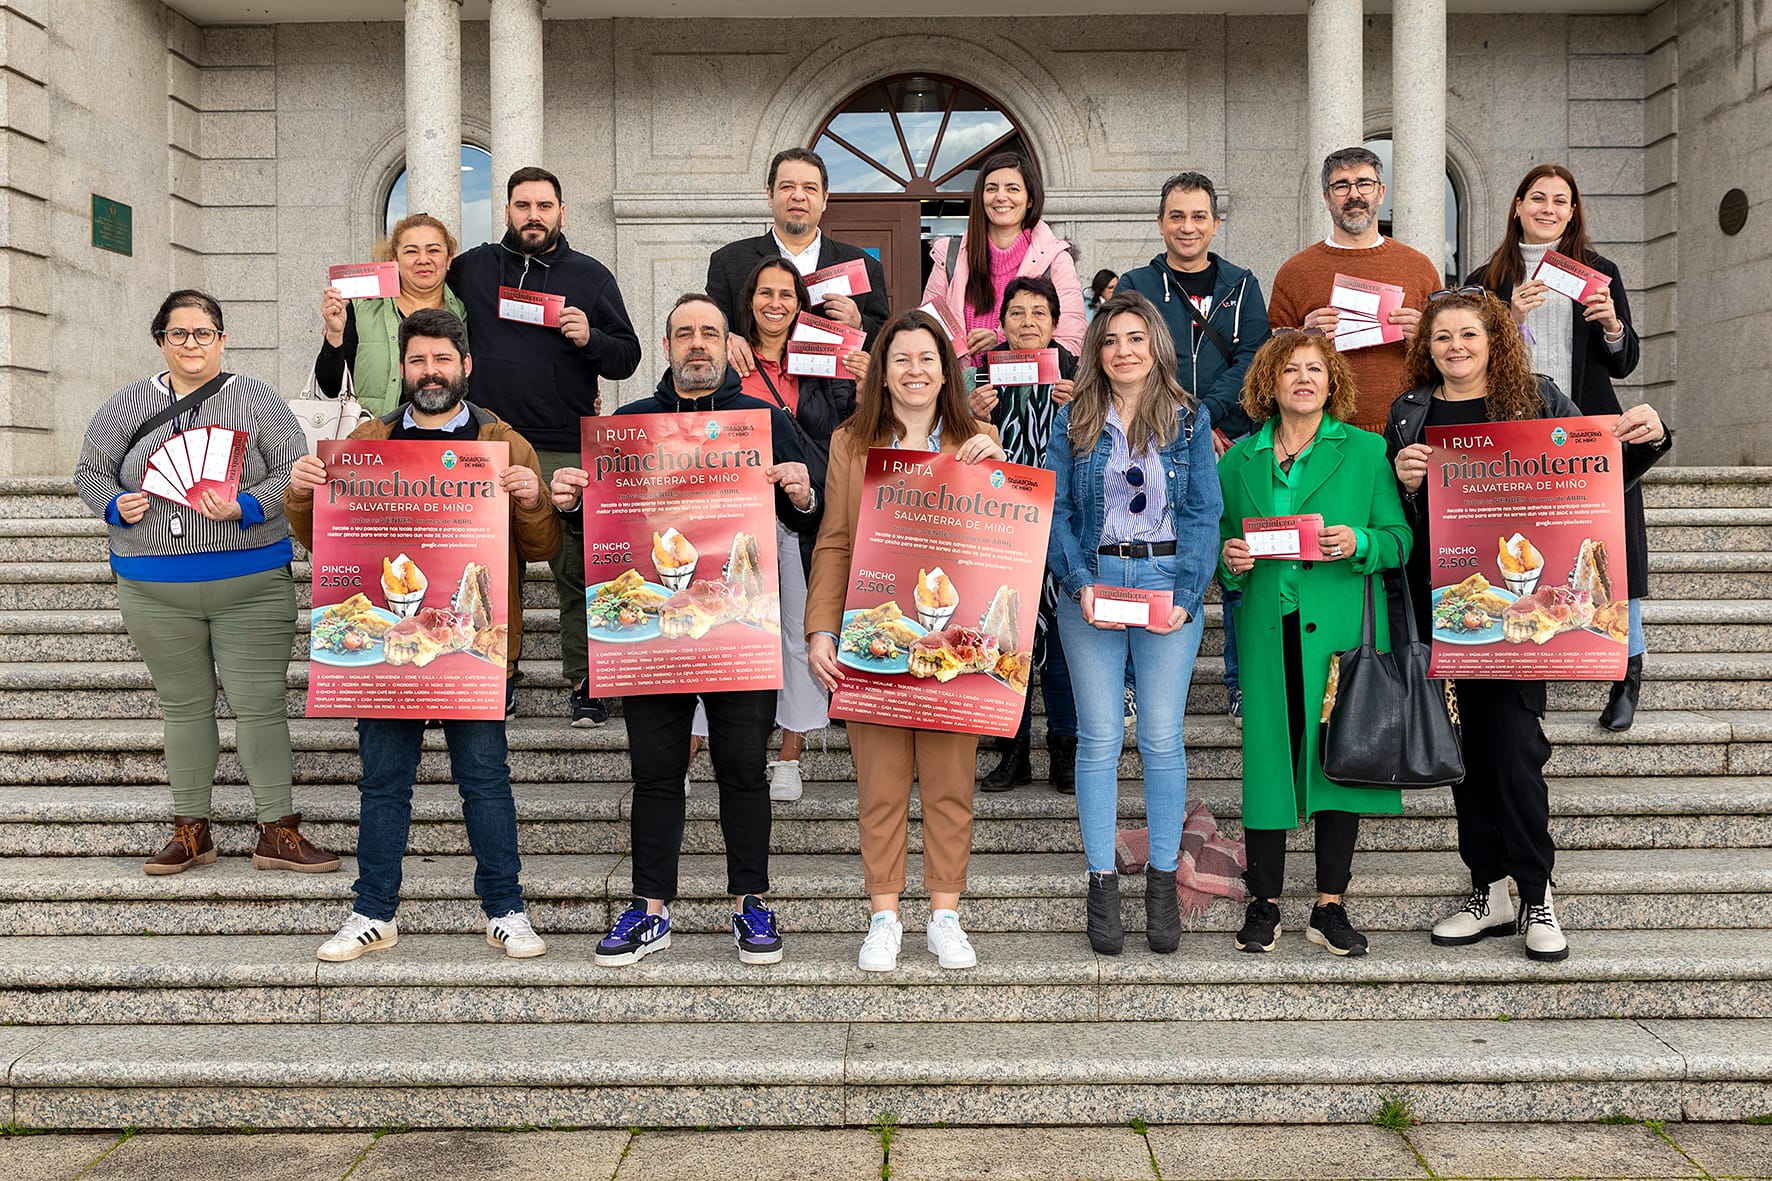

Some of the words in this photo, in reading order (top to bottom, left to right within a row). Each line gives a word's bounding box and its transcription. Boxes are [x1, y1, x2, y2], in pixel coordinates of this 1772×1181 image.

[606, 428, 648, 441] RUTA
[1453, 436, 1494, 449] RUTA
[342, 453, 384, 466] RUTA
[594, 443, 762, 482] pinchoterra
[892, 461, 934, 477] RUTA
[1441, 450, 1610, 488] pinchoterra
[615, 476, 687, 487] SALVATERRA
[690, 474, 705, 484] DE
[709, 472, 740, 483] MIÑO
[1462, 481, 1533, 494] SALVATERRA
[1537, 481, 1552, 491] DE
[1555, 478, 1587, 490] MIÑO
[328, 469, 497, 504] pinchoterra
[349, 502, 420, 512] SALVATERRA
[423, 503, 439, 512] DE
[443, 502, 474, 513] MIÑO
[874, 480, 1040, 523] pinchoterra
[894, 510, 962, 528] SALVATERRA
[965, 519, 981, 530] DE
[984, 519, 1016, 535] MIÑO
[592, 542, 631, 551] PINCHO
[1439, 546, 1477, 555] PINCHO
[591, 552, 633, 566] 2,50€
[1438, 556, 1479, 568] 2,50€
[321, 565, 360, 574] PINCHO
[859, 569, 896, 582] PINCHO
[320, 575, 362, 588] 2,50€
[855, 579, 897, 595] 2,50€
